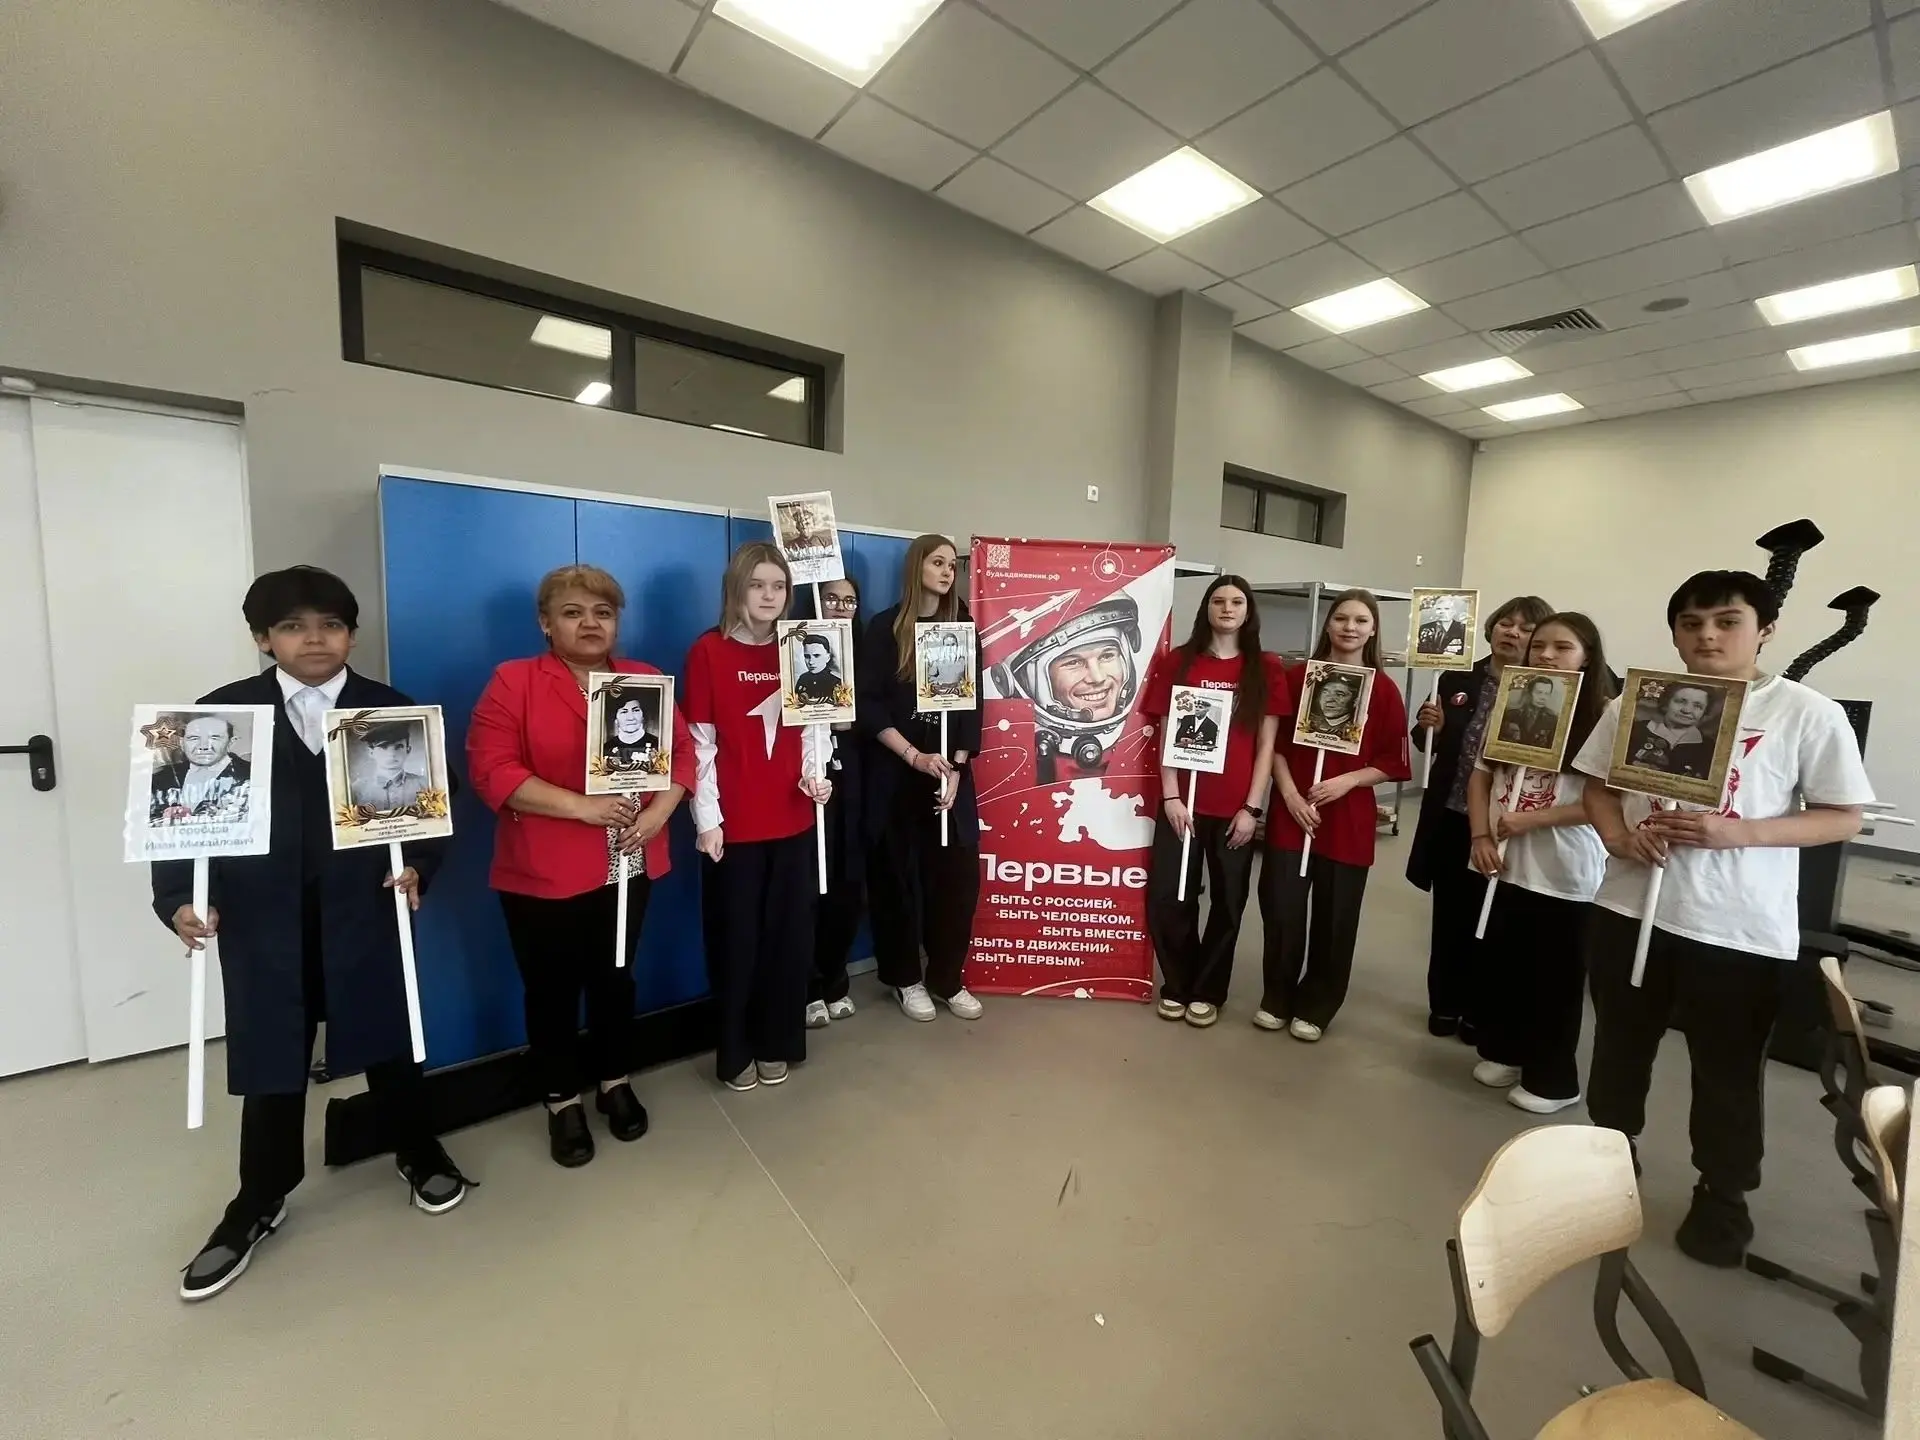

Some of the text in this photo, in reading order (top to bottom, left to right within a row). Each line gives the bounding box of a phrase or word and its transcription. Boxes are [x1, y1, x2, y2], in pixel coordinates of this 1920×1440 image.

[738, 671, 780, 684] Первы
[1032, 897, 1042, 906] С
[1016, 939, 1025, 949] В
